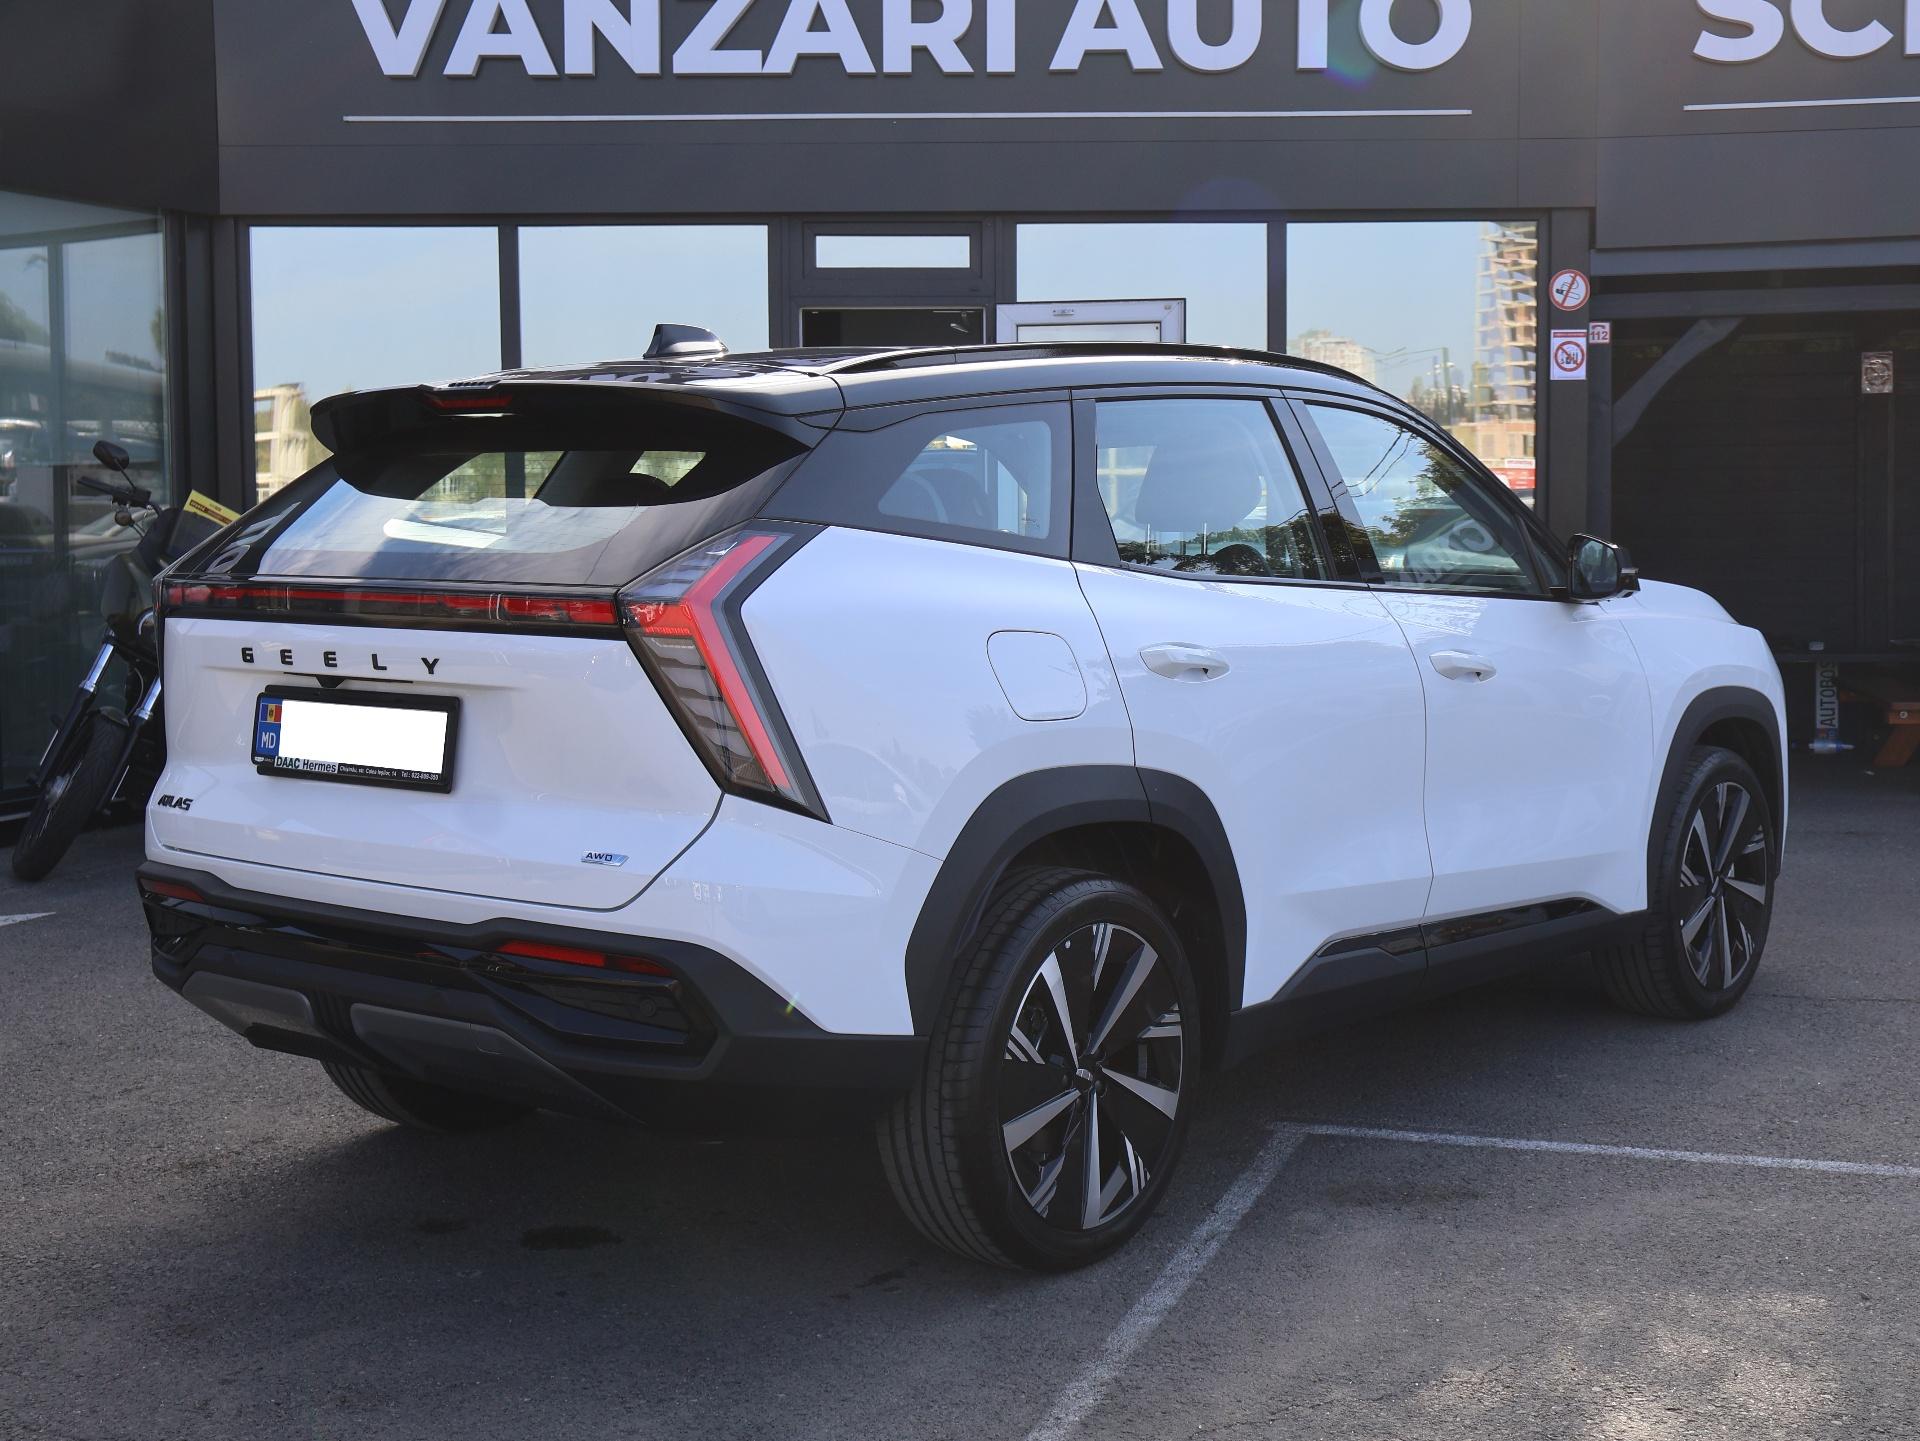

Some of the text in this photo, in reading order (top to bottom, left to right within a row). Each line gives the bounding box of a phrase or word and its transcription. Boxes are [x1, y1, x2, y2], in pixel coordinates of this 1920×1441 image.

[1691, 0, 1920, 64] SC
[1590, 331, 1608, 340] 112
[241, 647, 440, 675] GEELY
[261, 731, 276, 749] MD
[276, 756, 301, 769] DAAC
[302, 759, 337, 773] Hermes
[585, 852, 613, 862] AWD
